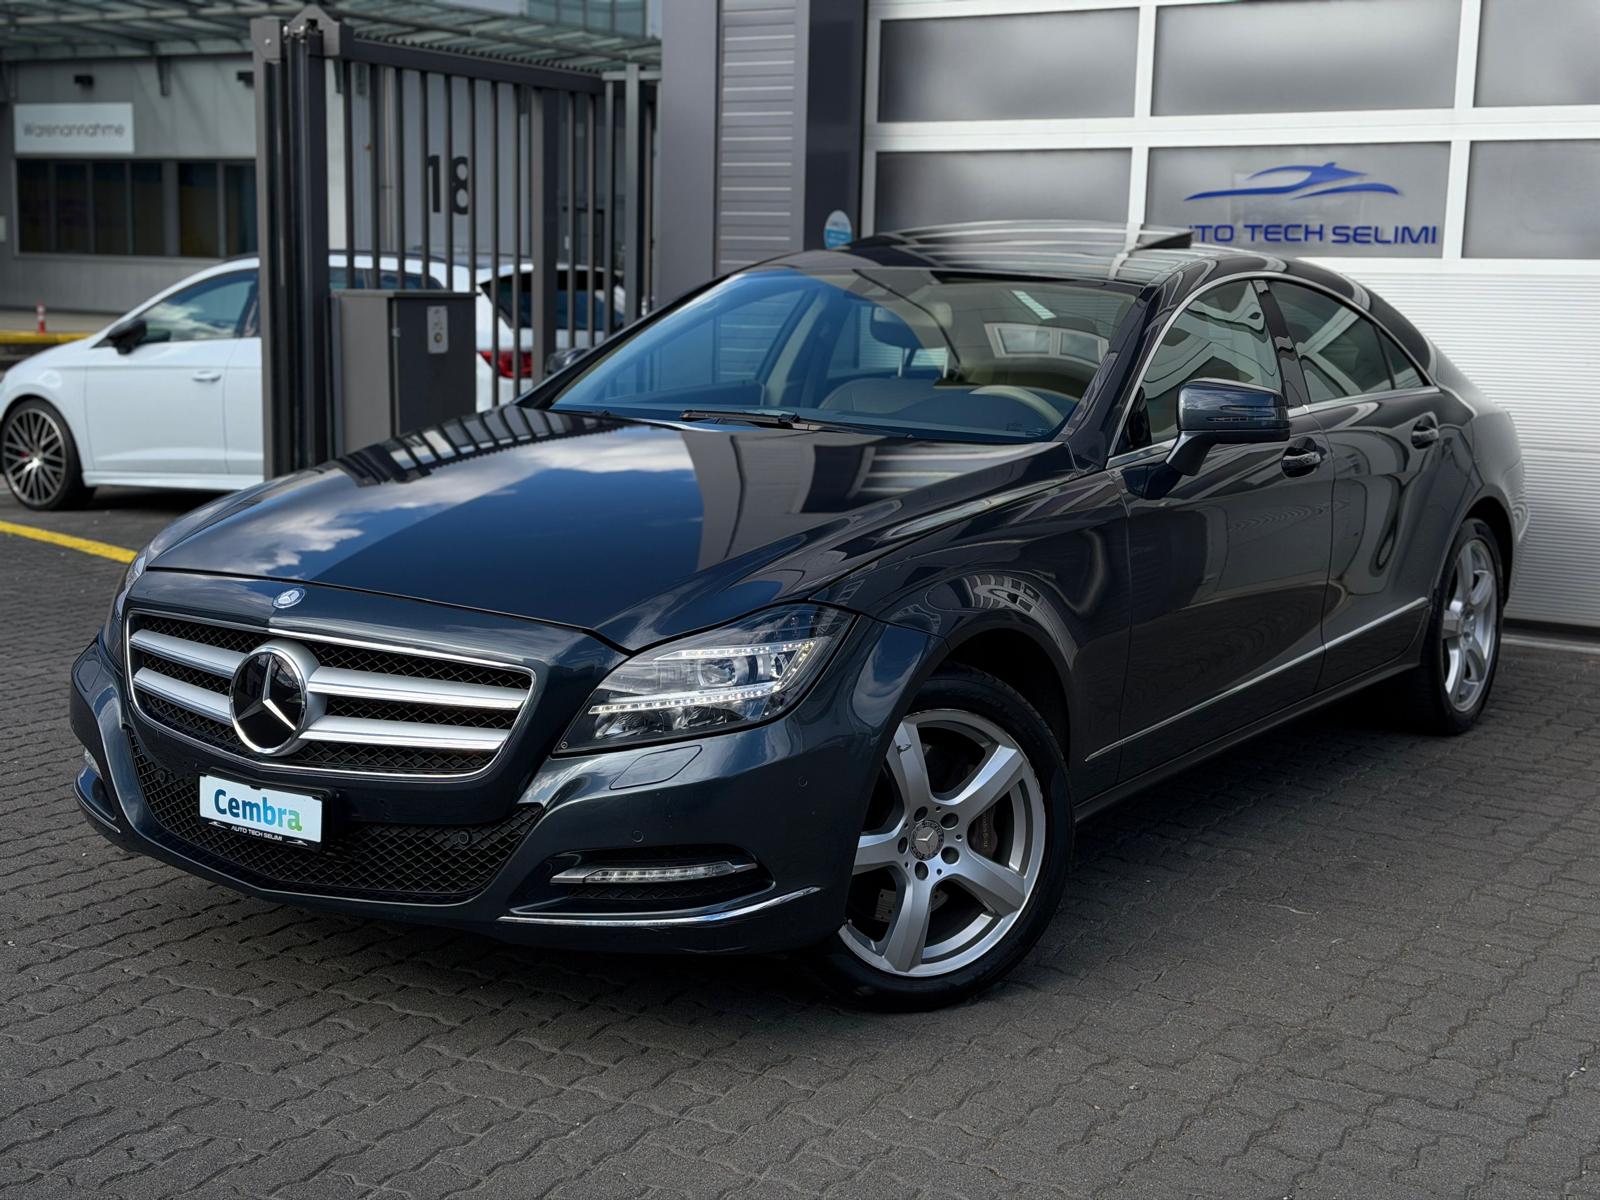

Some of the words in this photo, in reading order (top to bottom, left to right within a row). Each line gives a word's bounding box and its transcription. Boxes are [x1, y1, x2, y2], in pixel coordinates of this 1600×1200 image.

[426, 154, 470, 215] 18
[1244, 224, 1324, 242] TECH
[1332, 226, 1437, 244] SELIMI
[214, 788, 303, 832] Cembra
[230, 825, 247, 834] AUTO
[248, 829, 263, 837] TECH
